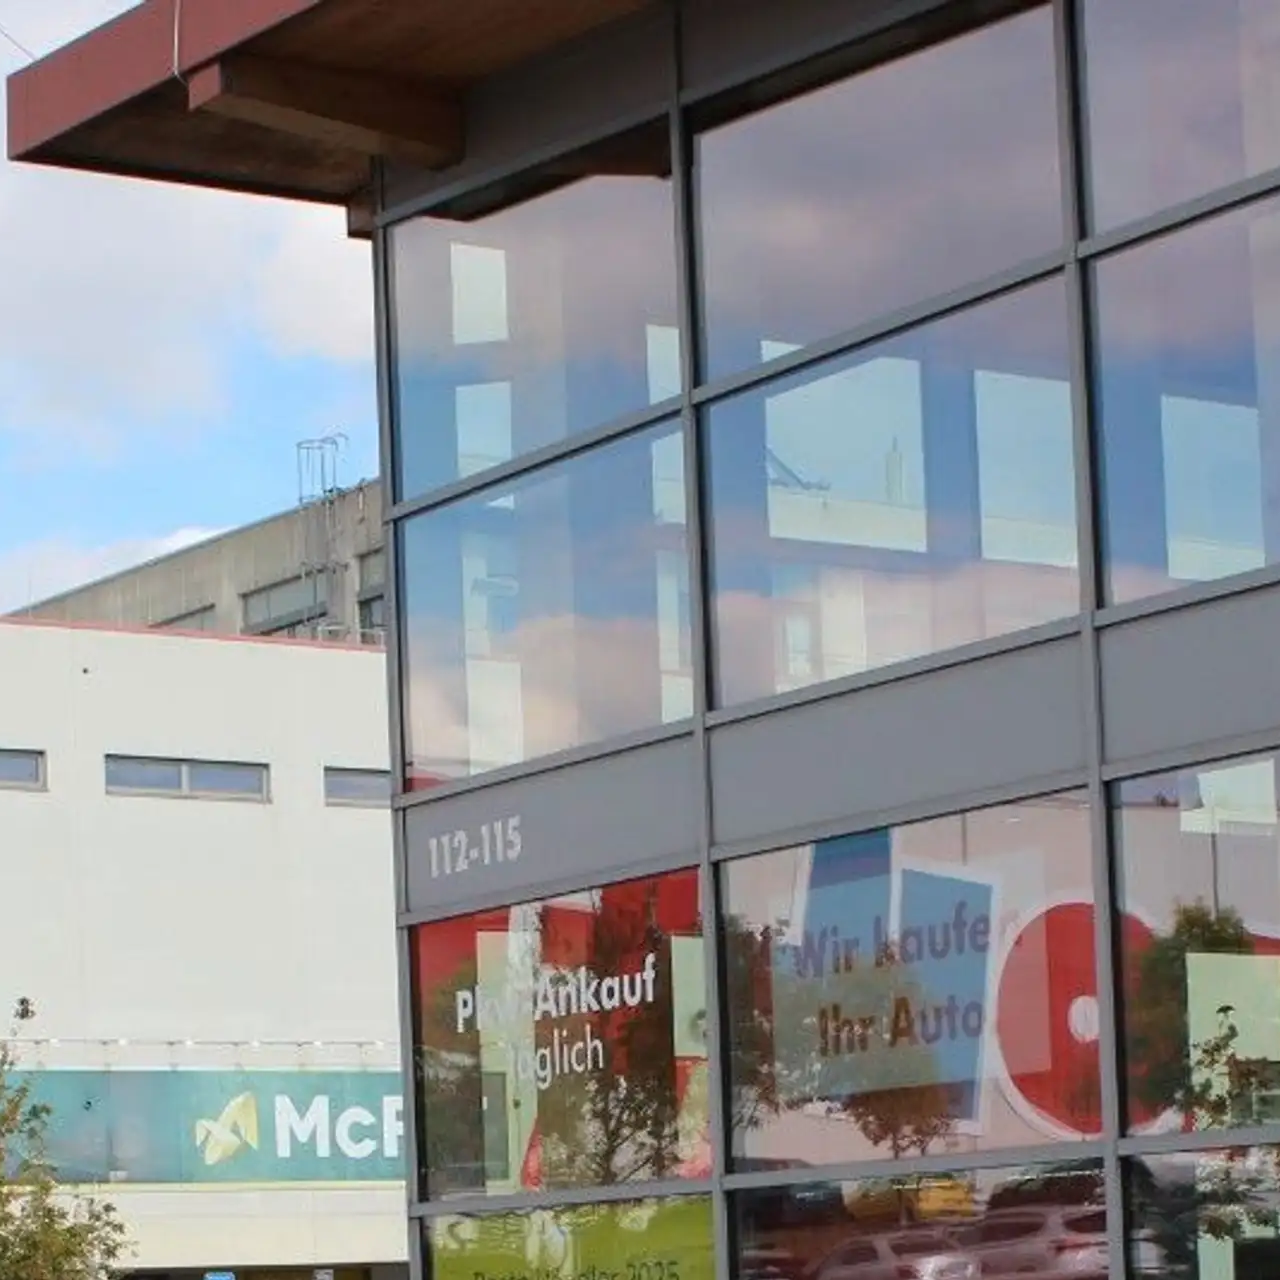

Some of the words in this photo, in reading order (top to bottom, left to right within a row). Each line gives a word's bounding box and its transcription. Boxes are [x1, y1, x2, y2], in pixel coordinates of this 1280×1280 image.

[428, 815, 521, 878] 112-115
[794, 924, 859, 979] Wir
[534, 952, 656, 1021] Ankauf
[818, 1002, 876, 1058] Ihr
[888, 994, 983, 1048] Auto
